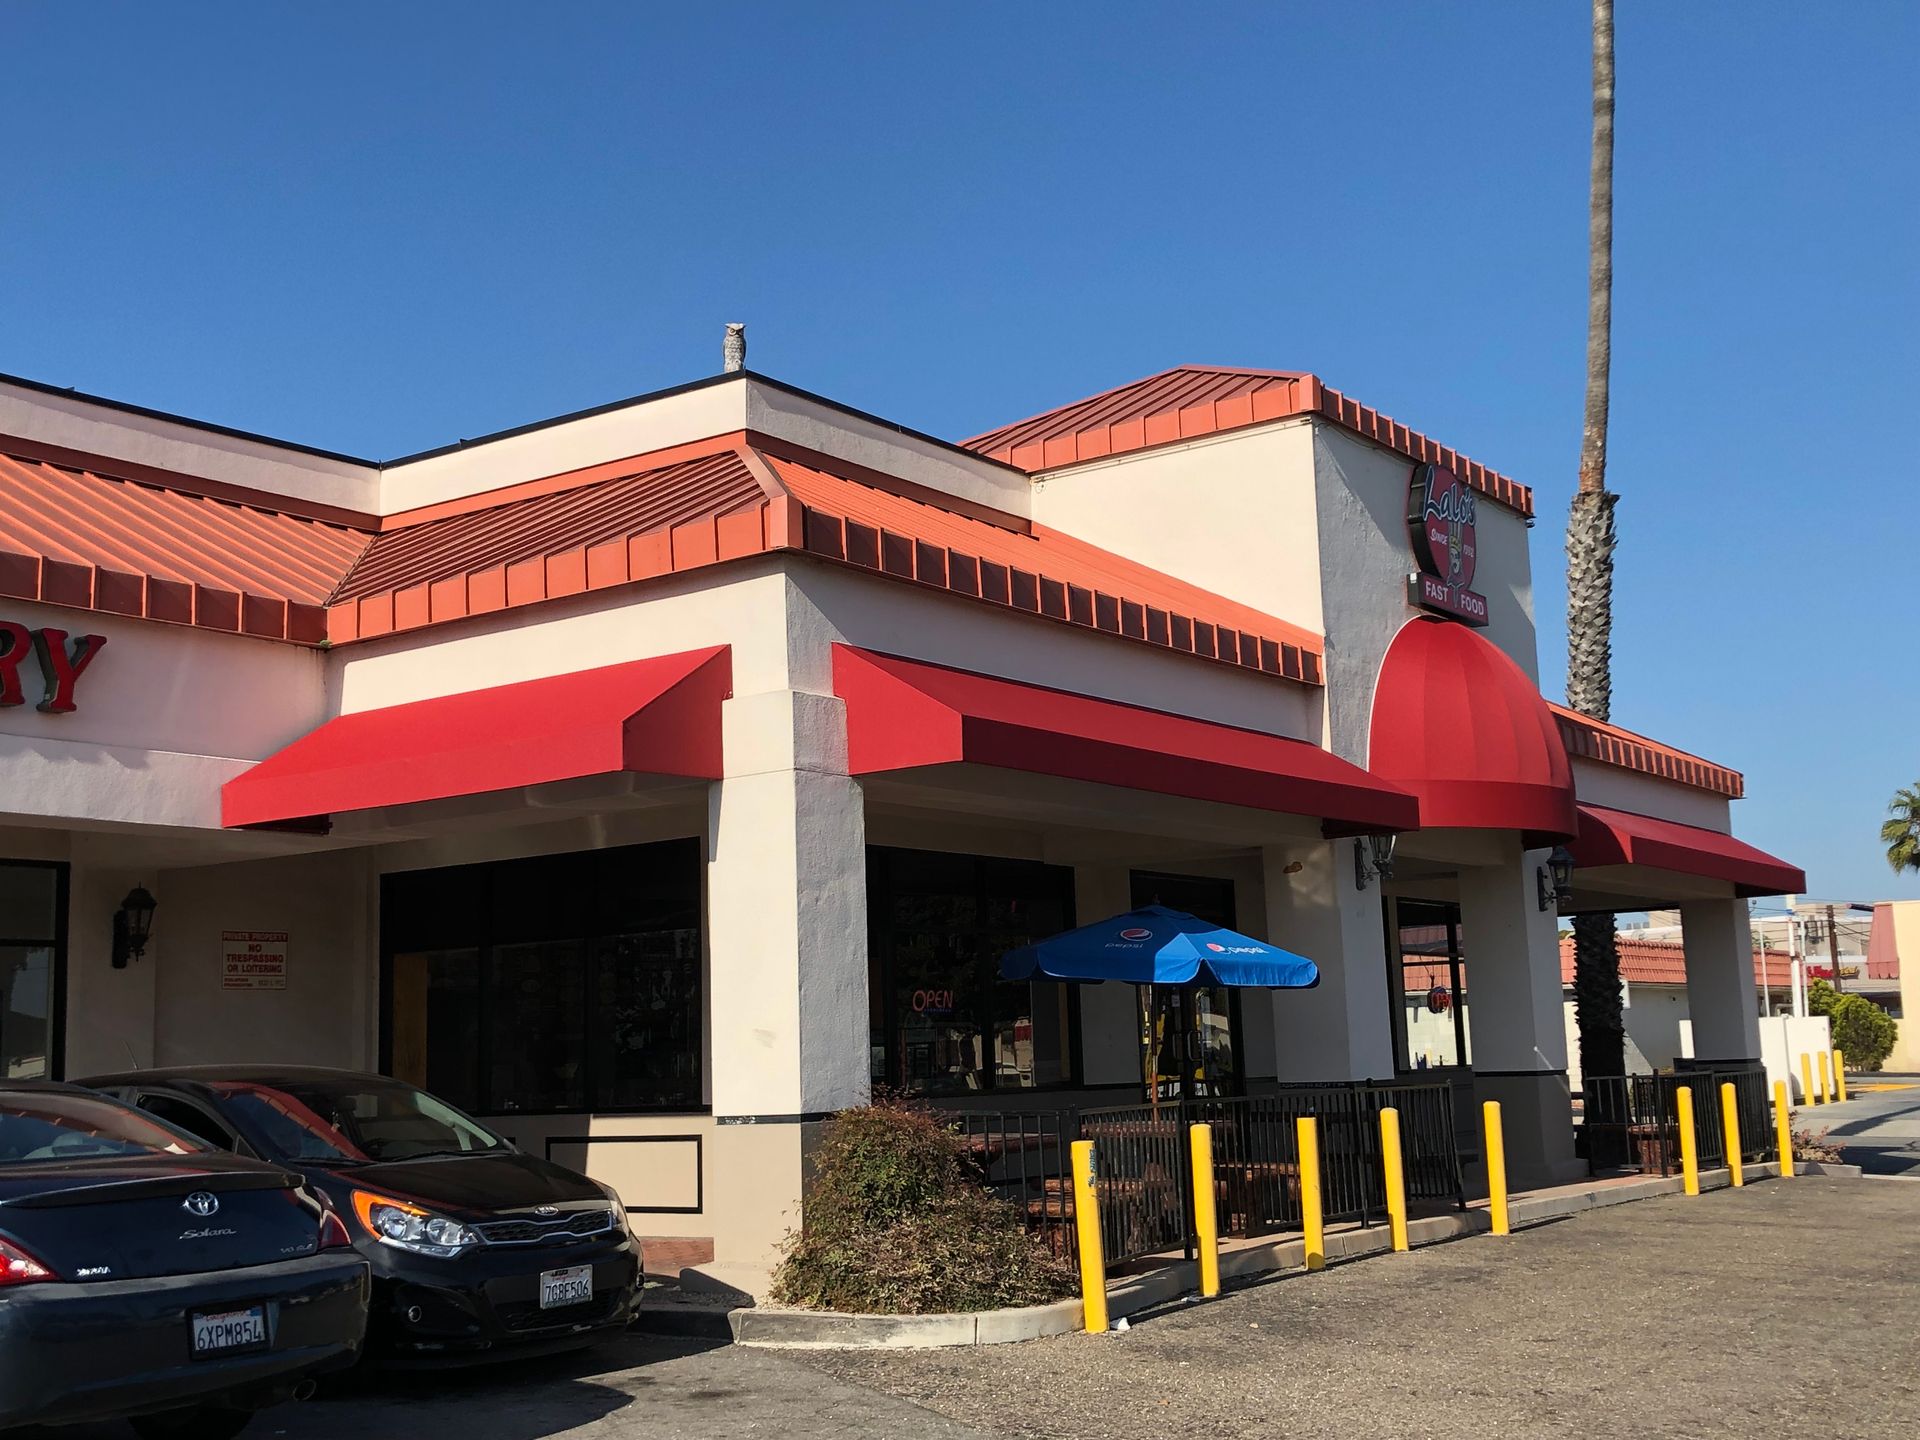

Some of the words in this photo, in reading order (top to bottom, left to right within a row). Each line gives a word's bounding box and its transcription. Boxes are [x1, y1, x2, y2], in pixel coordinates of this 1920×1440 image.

[1423, 465, 1475, 526] Lalo's
[1425, 580, 1449, 603] FAST
[1460, 594, 1484, 616] FOOD
[226, 953, 284, 963] TRESPASSING
[248, 943, 262, 953] NO
[227, 964, 239, 973] OR
[241, 964, 282, 974] LOITERING
[912, 989, 954, 1012] OPEN
[179, 1227, 237, 1239] Solara
[545, 1279, 589, 1301] 7GBF506
[196, 1318, 263, 1350] 6XPM854
